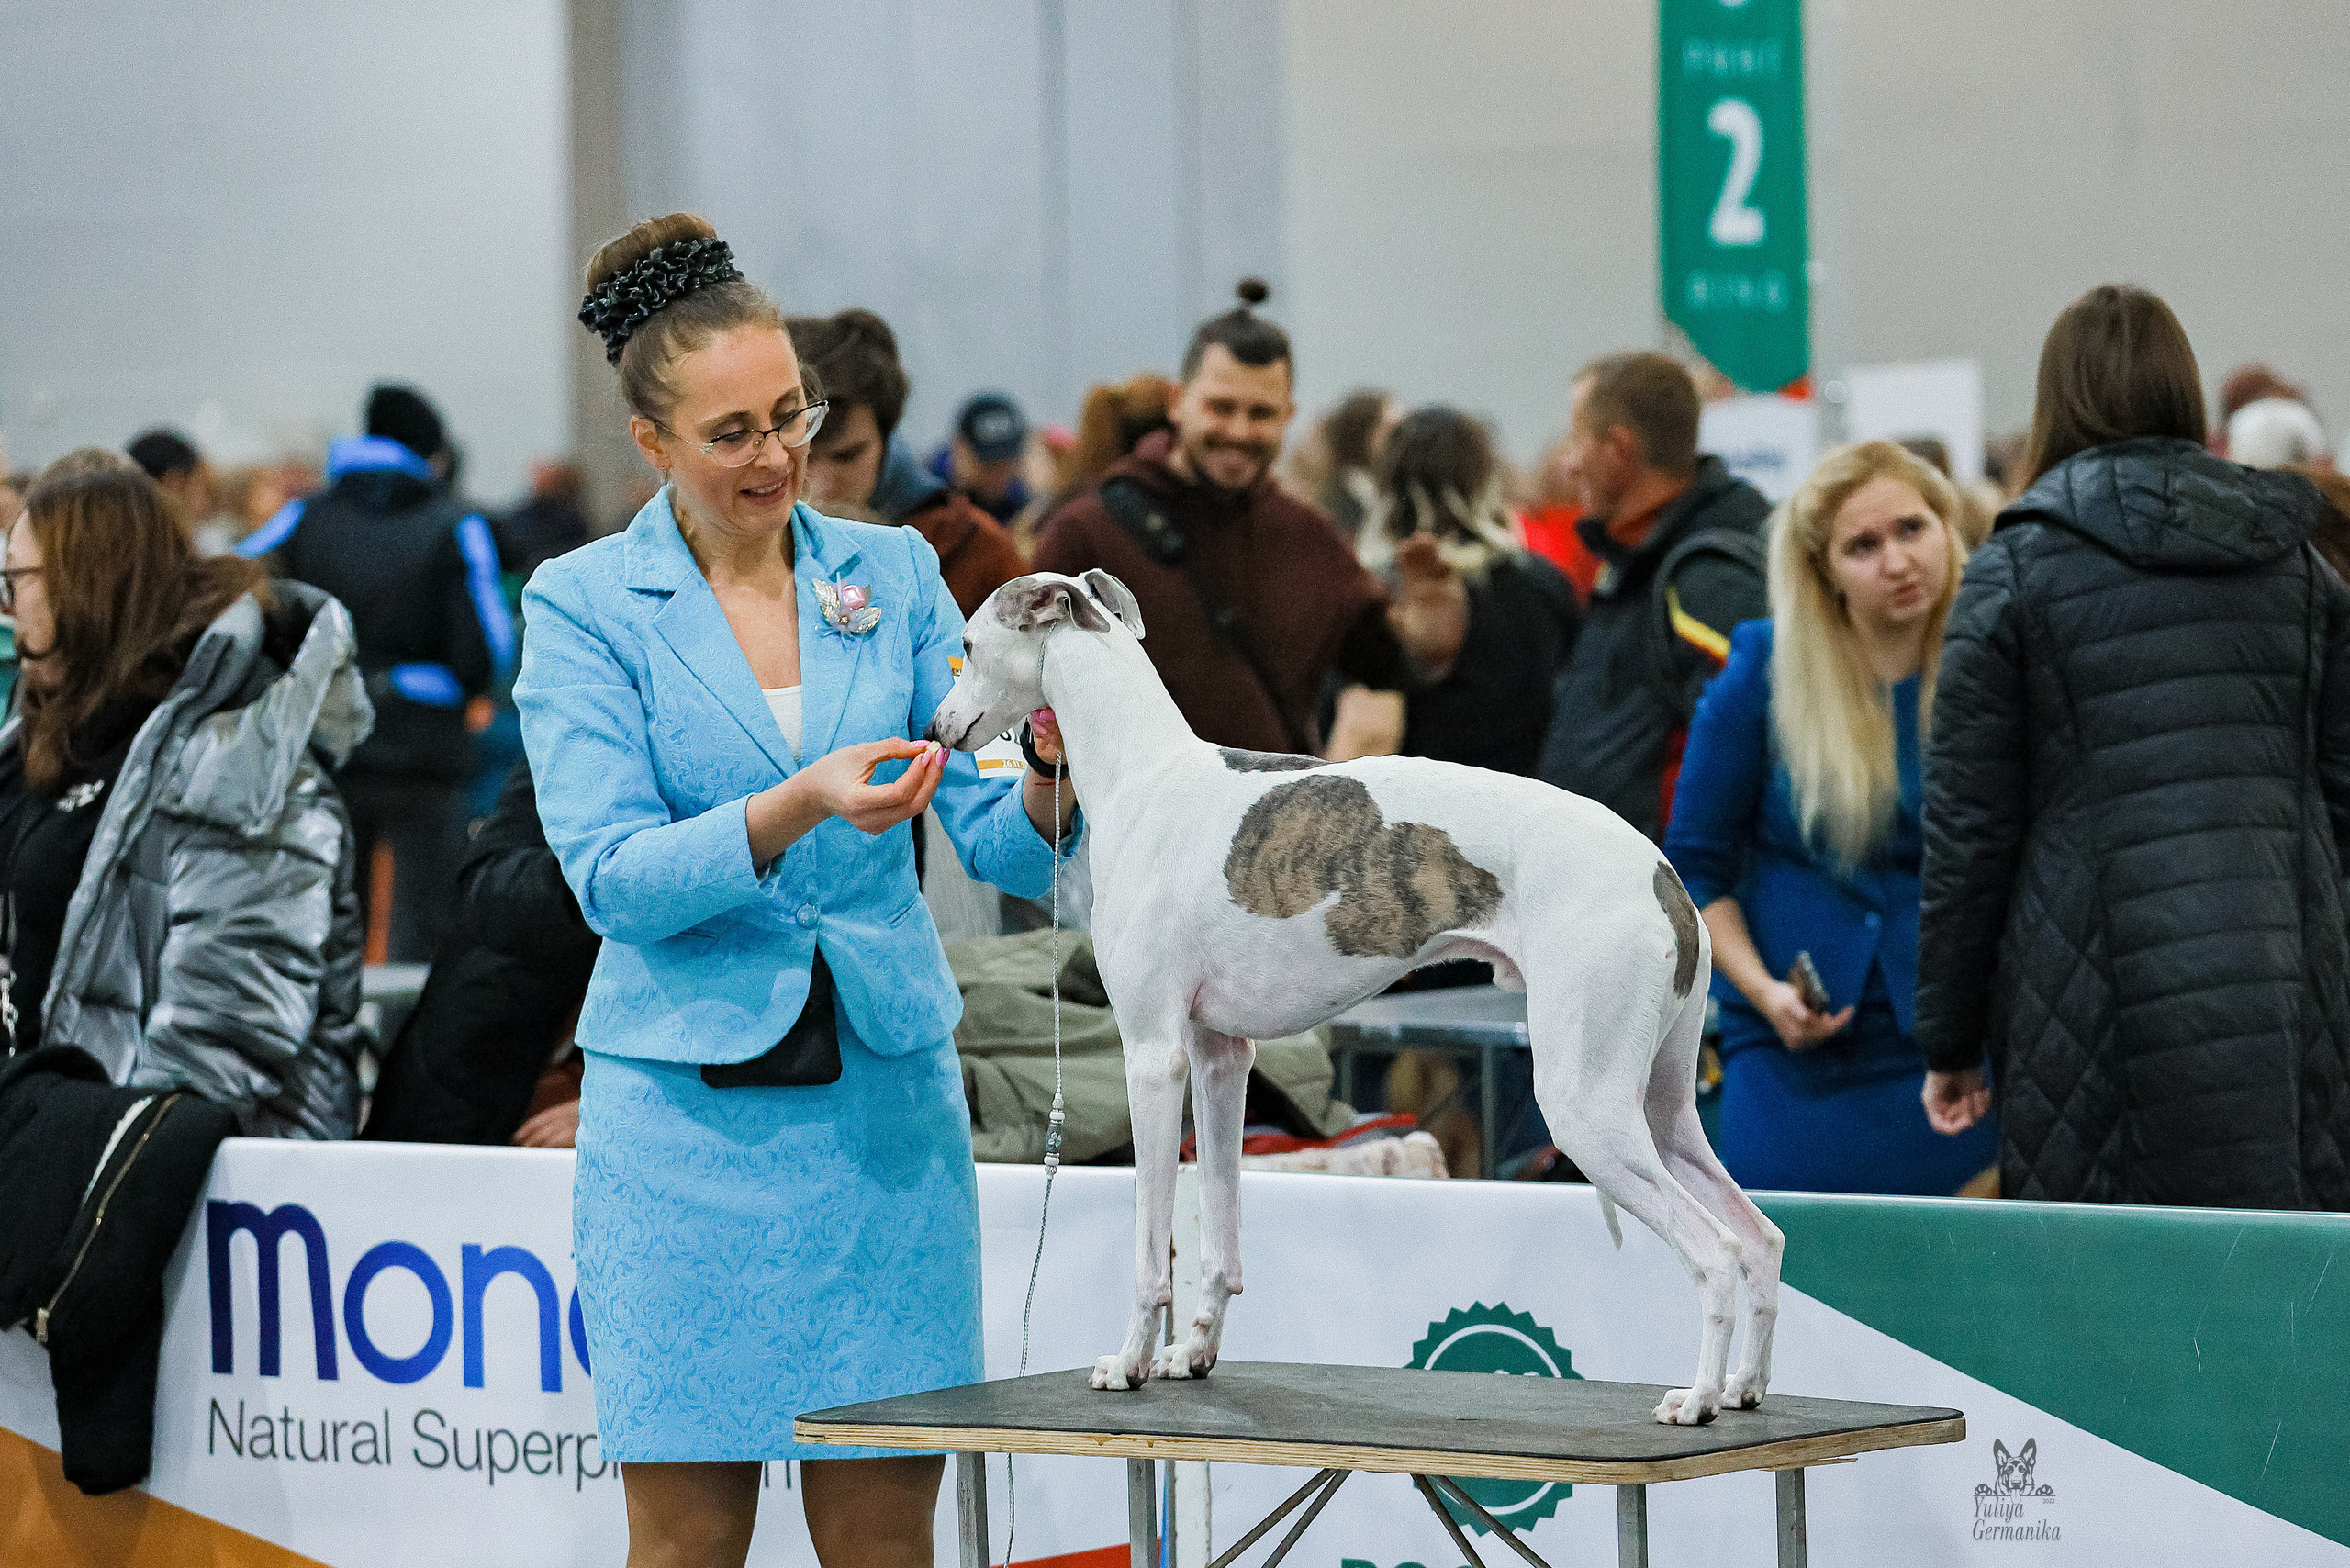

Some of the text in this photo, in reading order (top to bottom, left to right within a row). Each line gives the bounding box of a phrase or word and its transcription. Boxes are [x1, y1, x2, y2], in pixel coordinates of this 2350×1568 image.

[1707, 96, 1766, 248] 2
[207, 1199, 592, 1393] mon
[207, 1398, 392, 1466] Natural
